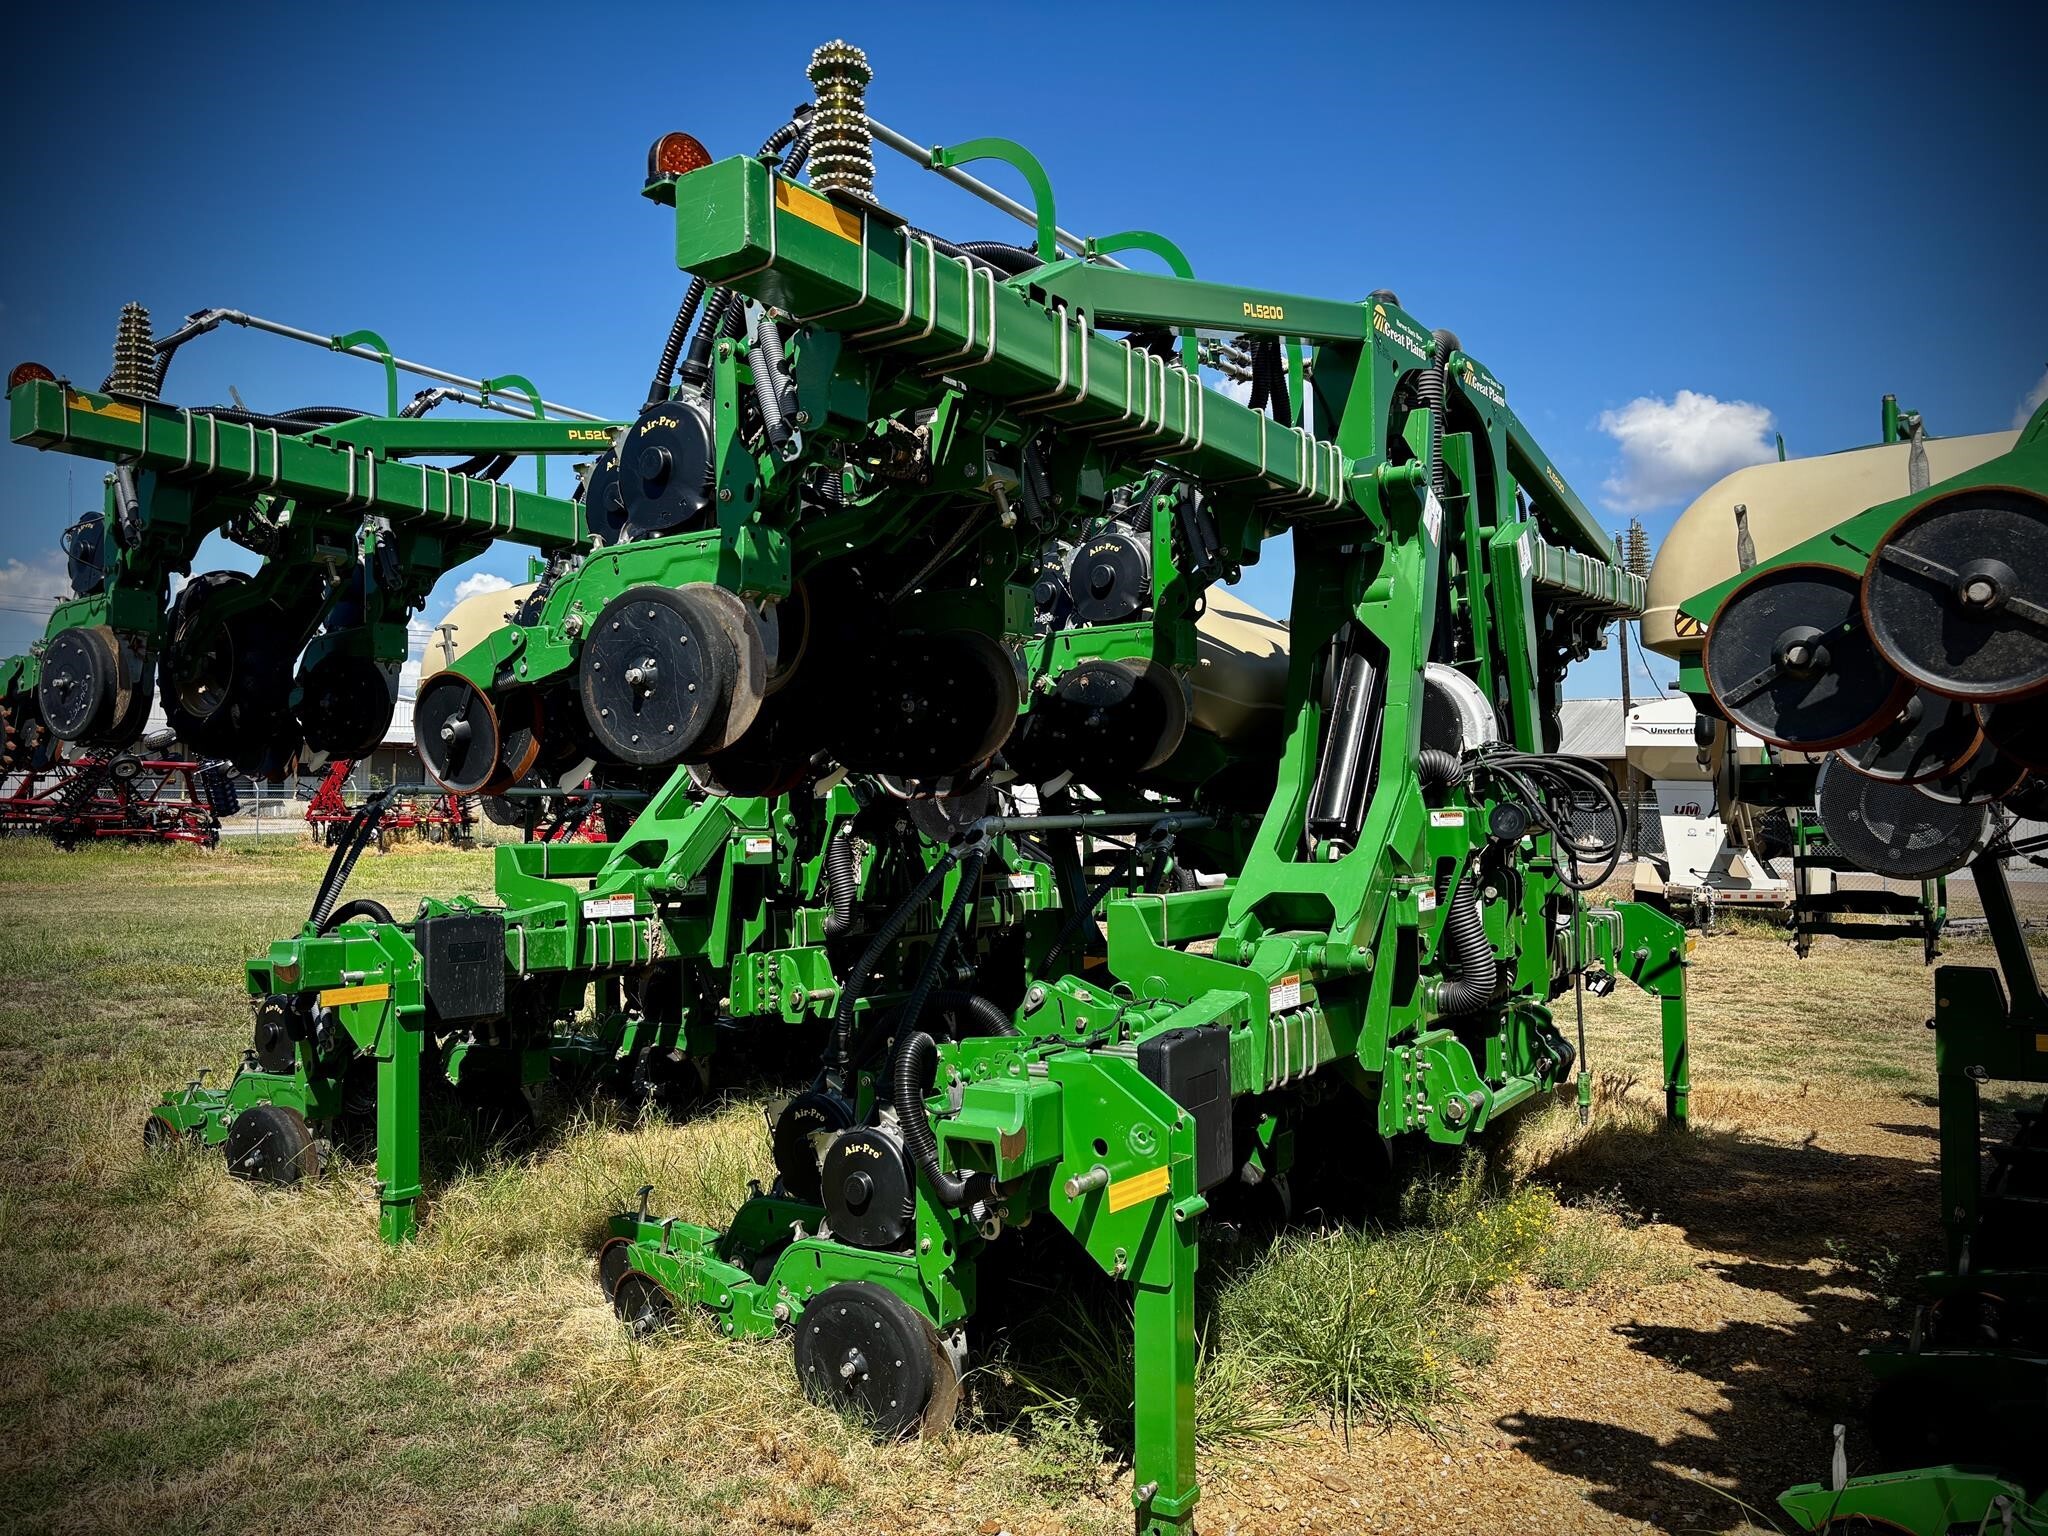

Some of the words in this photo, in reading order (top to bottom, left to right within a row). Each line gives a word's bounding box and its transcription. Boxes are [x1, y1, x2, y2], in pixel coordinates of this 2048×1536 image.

[1243, 302, 1284, 320] PL5200
[1384, 322, 1405, 347] Great
[1405, 335, 1427, 361] Plains
[1471, 375, 1489, 396] Great
[1488, 386, 1505, 408] Plains
[640, 415, 677, 437] Air-Pro
[568, 430, 611, 440] PL52
[1089, 543, 1120, 557] Air-Pro
[794, 1108, 825, 1122] Air-Pro
[844, 1143, 880, 1159] Air-Pro
